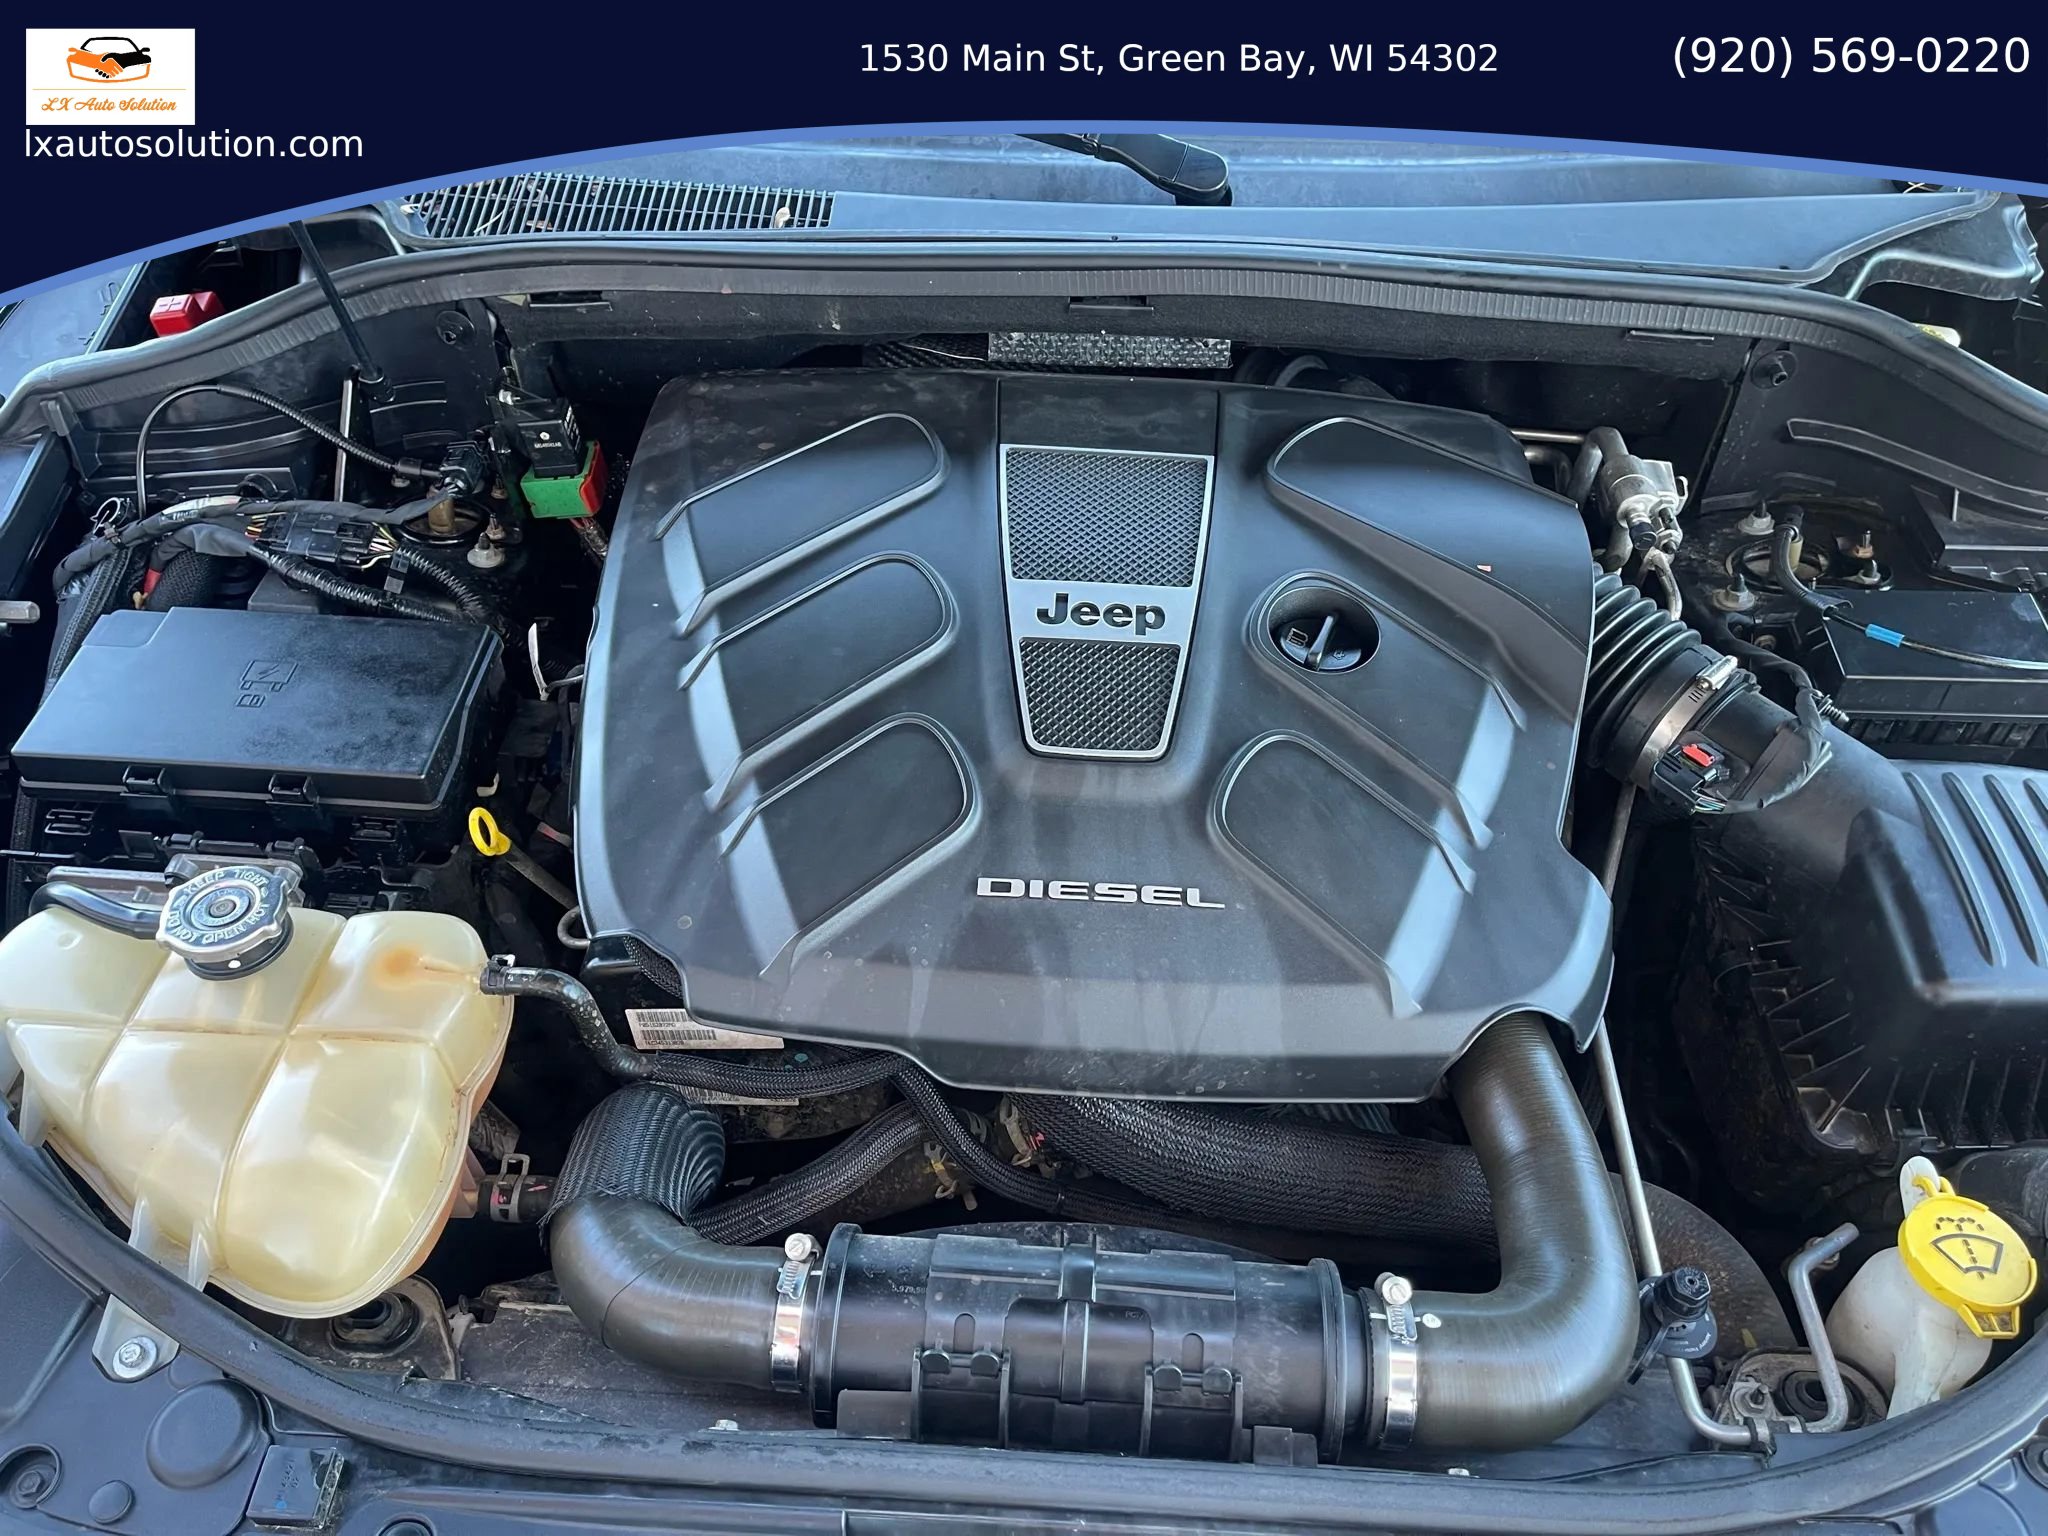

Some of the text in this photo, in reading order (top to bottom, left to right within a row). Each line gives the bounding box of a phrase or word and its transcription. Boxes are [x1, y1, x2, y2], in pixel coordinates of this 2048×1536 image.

[1036, 592, 1166, 636] Jeep
[183, 869, 269, 894] KEEP TIGHT
[976, 877, 1226, 909] DIESEL
[202, 925, 246, 944] OPEN
[248, 904, 269, 924] HOT
